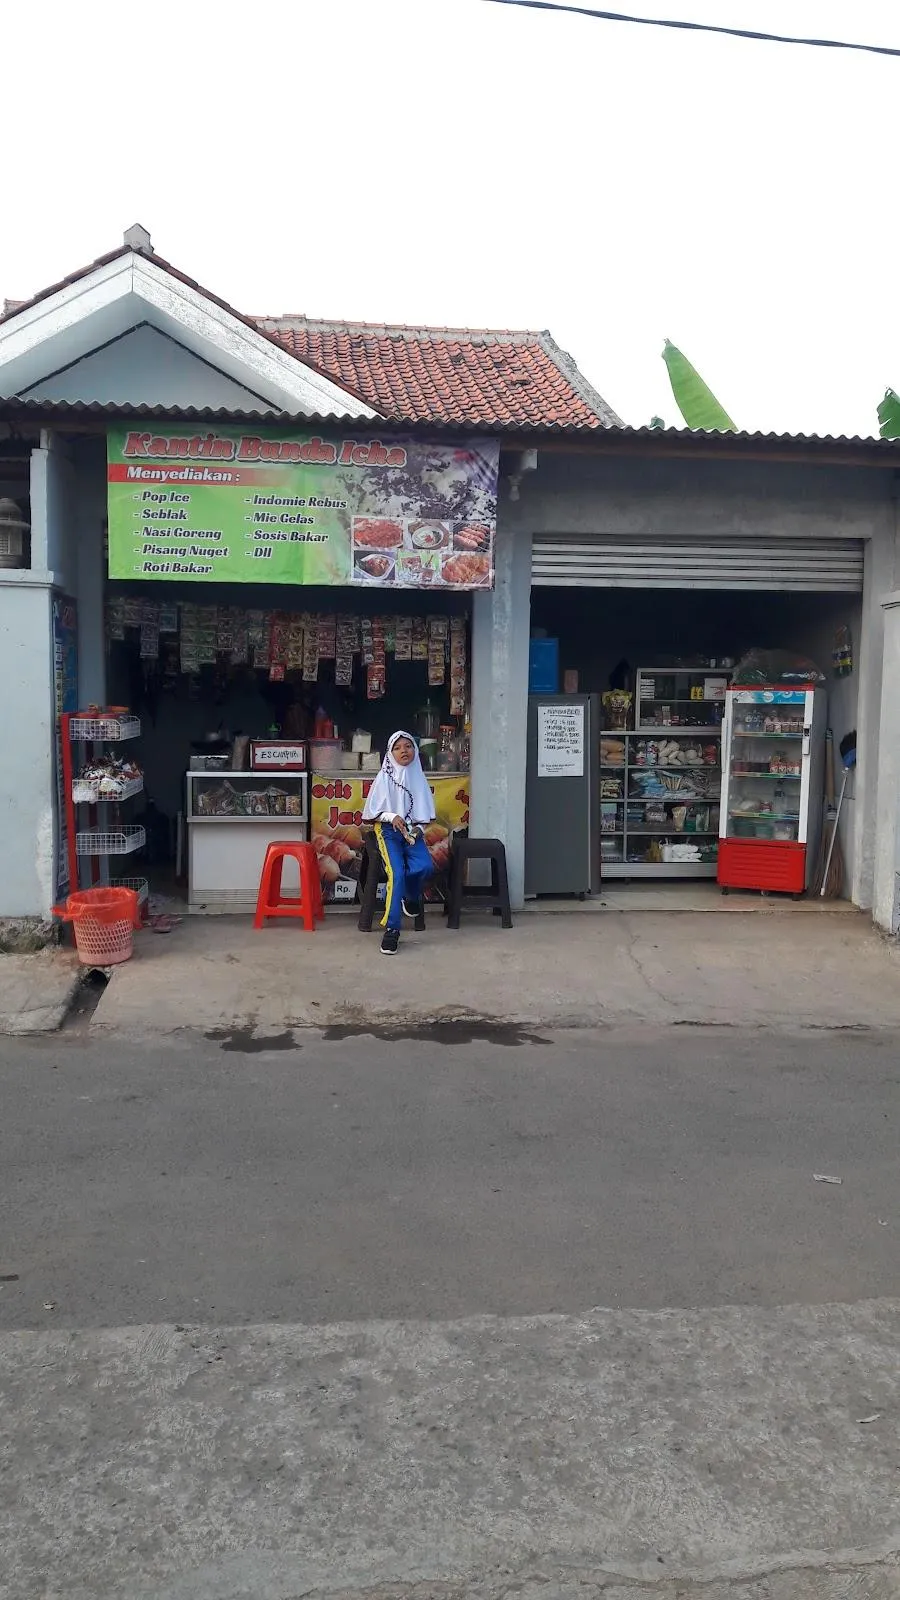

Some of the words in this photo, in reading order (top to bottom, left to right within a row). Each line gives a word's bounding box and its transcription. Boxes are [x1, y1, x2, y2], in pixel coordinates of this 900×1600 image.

[123, 431, 234, 459] Kantin
[236, 436, 336, 463] Bunda
[338, 440, 407, 467] Icha
[127, 466, 232, 482] Menyediakan
[142, 491, 167, 503] Pop
[169, 492, 190, 502] Ice
[253, 494, 306, 506] Indomie
[308, 496, 347, 508] Rebus
[142, 508, 187, 520] Seblak
[253, 512, 277, 523] Mie
[280, 513, 314, 524] Gelas
[142, 526, 171, 537] Nasi
[173, 527, 222, 540] Goreng
[253, 529, 287, 541] Sosis
[290, 531, 328, 542] Bakar
[142, 544, 187, 556] Pisang
[189, 545, 229, 557] Nuget
[143, 561, 170, 572] Roti
[172, 562, 212, 573] Bakar
[328, 806, 374, 829] Jas
